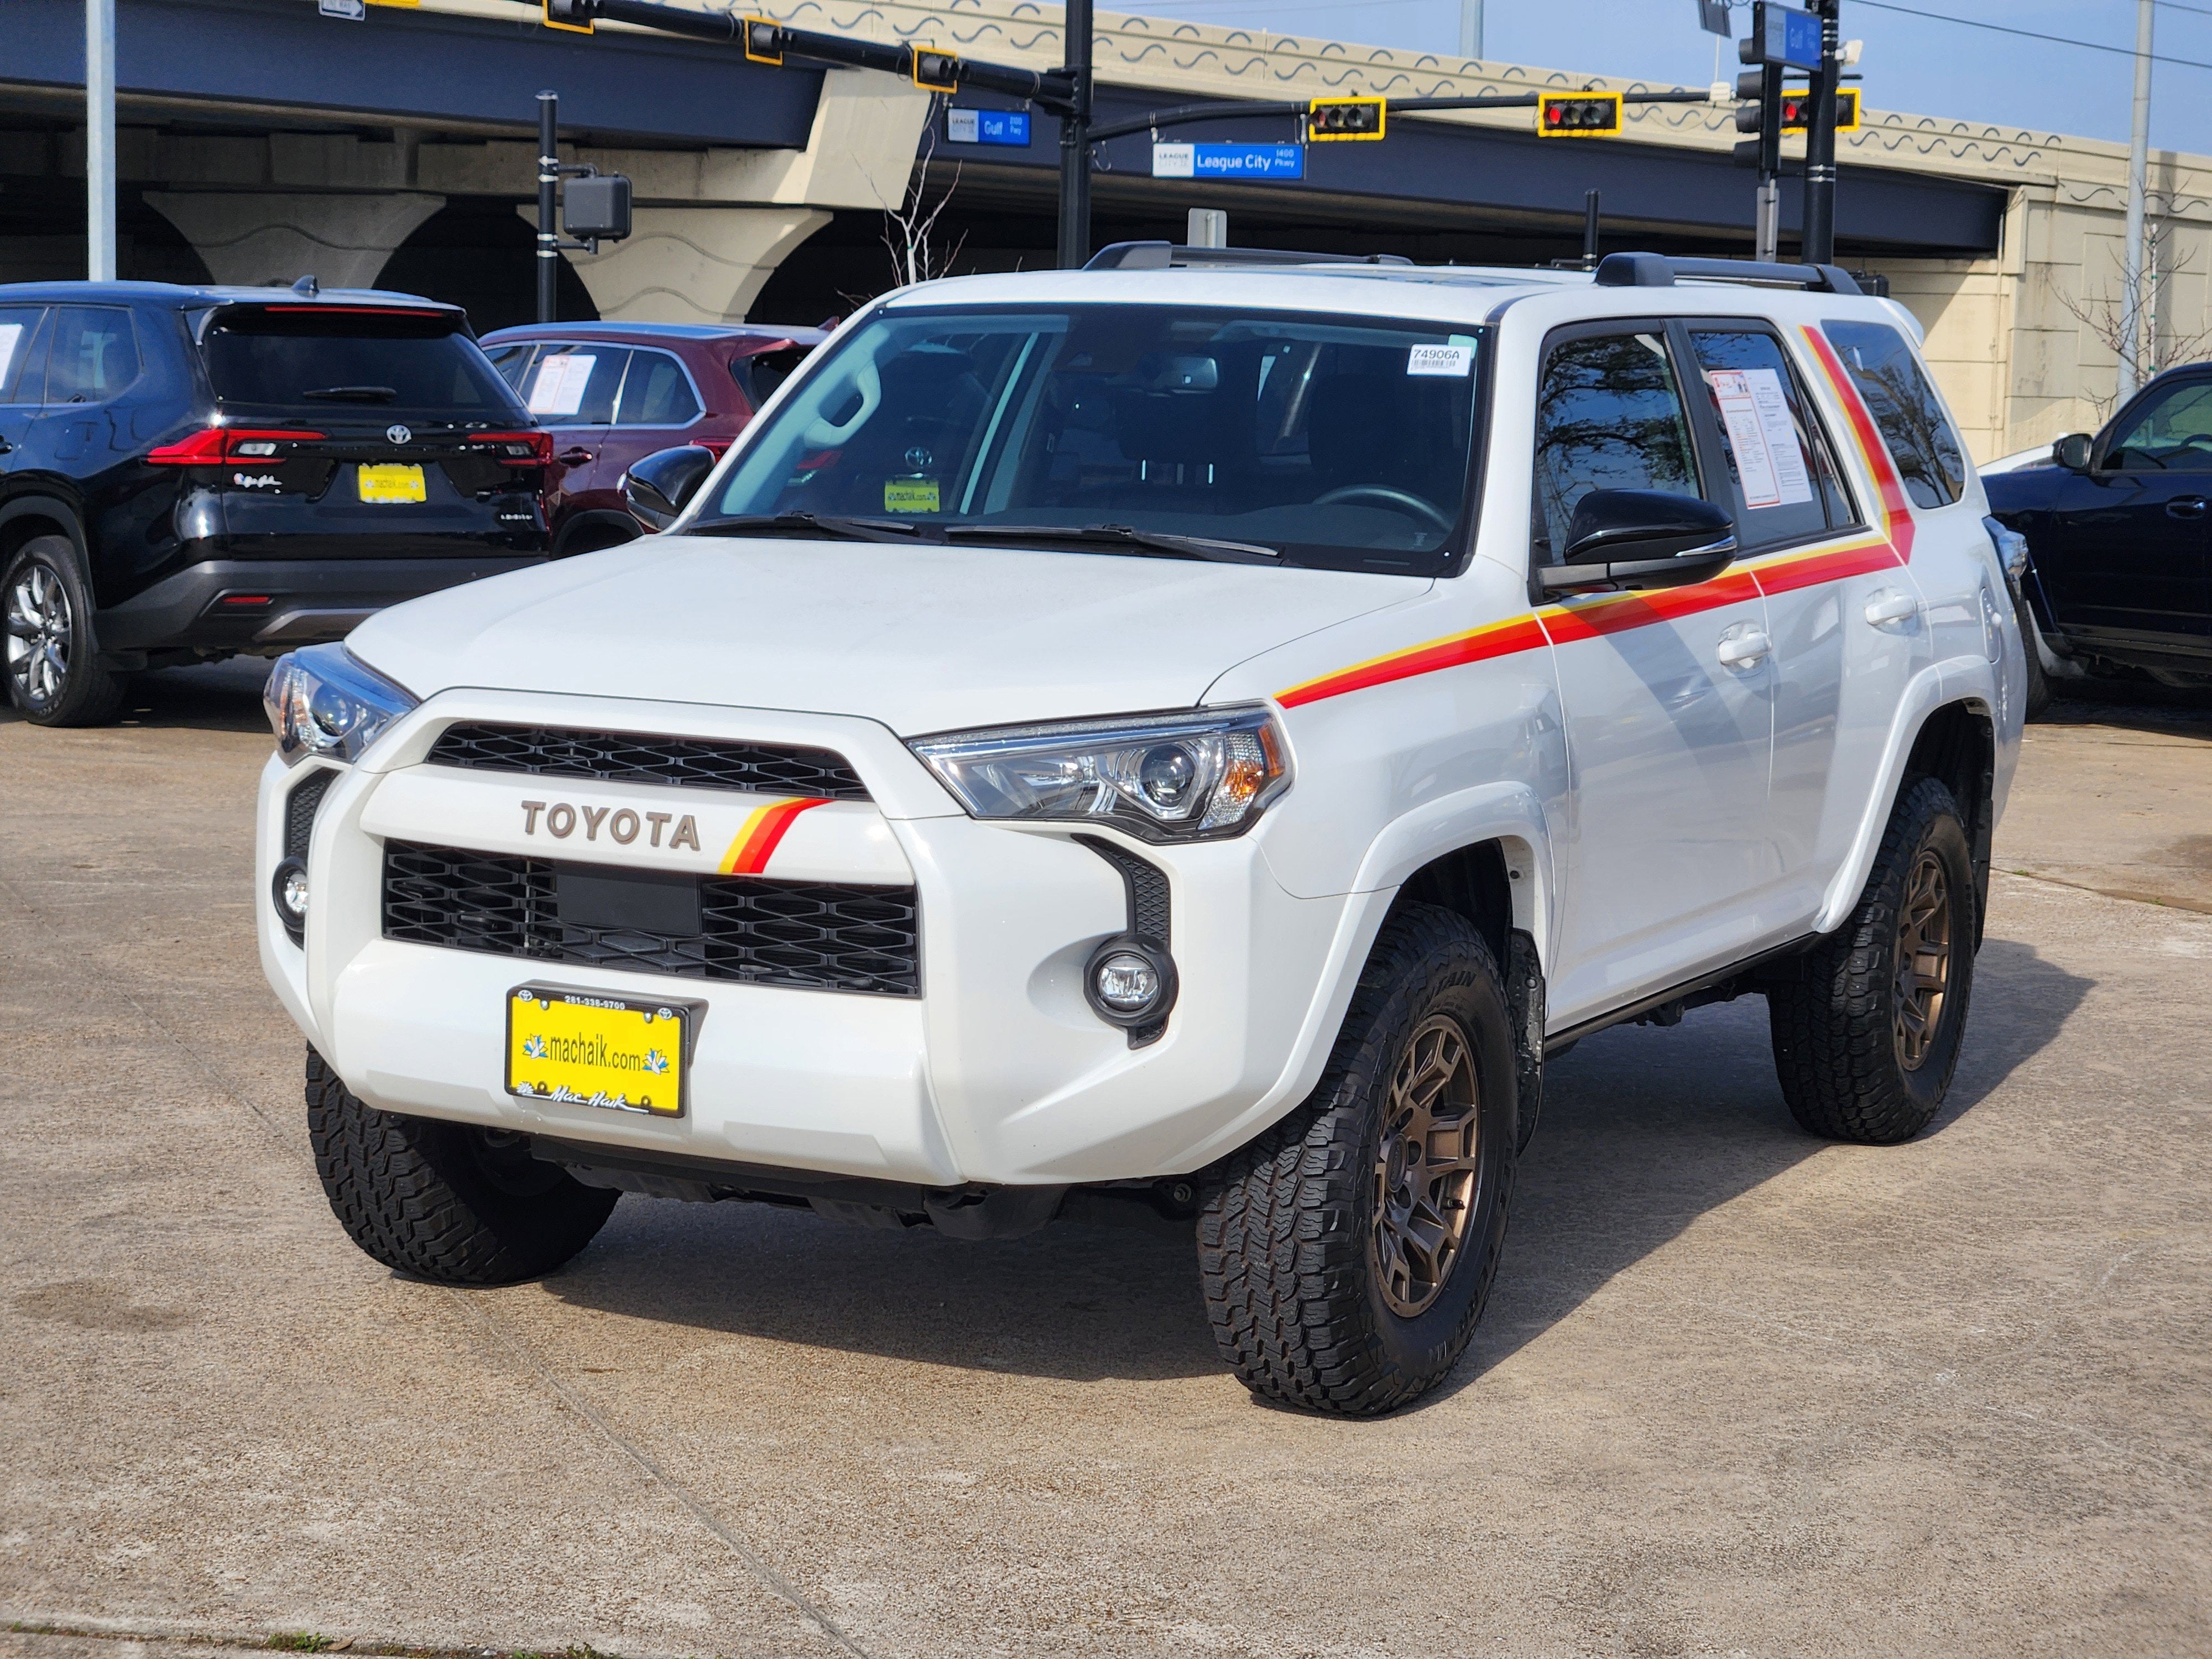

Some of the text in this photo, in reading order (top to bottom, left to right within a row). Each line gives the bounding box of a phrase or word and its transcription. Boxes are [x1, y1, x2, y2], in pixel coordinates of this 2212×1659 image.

[1197, 154, 1271, 173] League City
[1414, 349, 1460, 359] 74906A
[521, 800, 701, 852] TOYOTA
[564, 995, 626, 1010] 281-338-9700
[550, 1031, 641, 1072] machaik.com
[550, 1084, 628, 1110] Mac Haik
